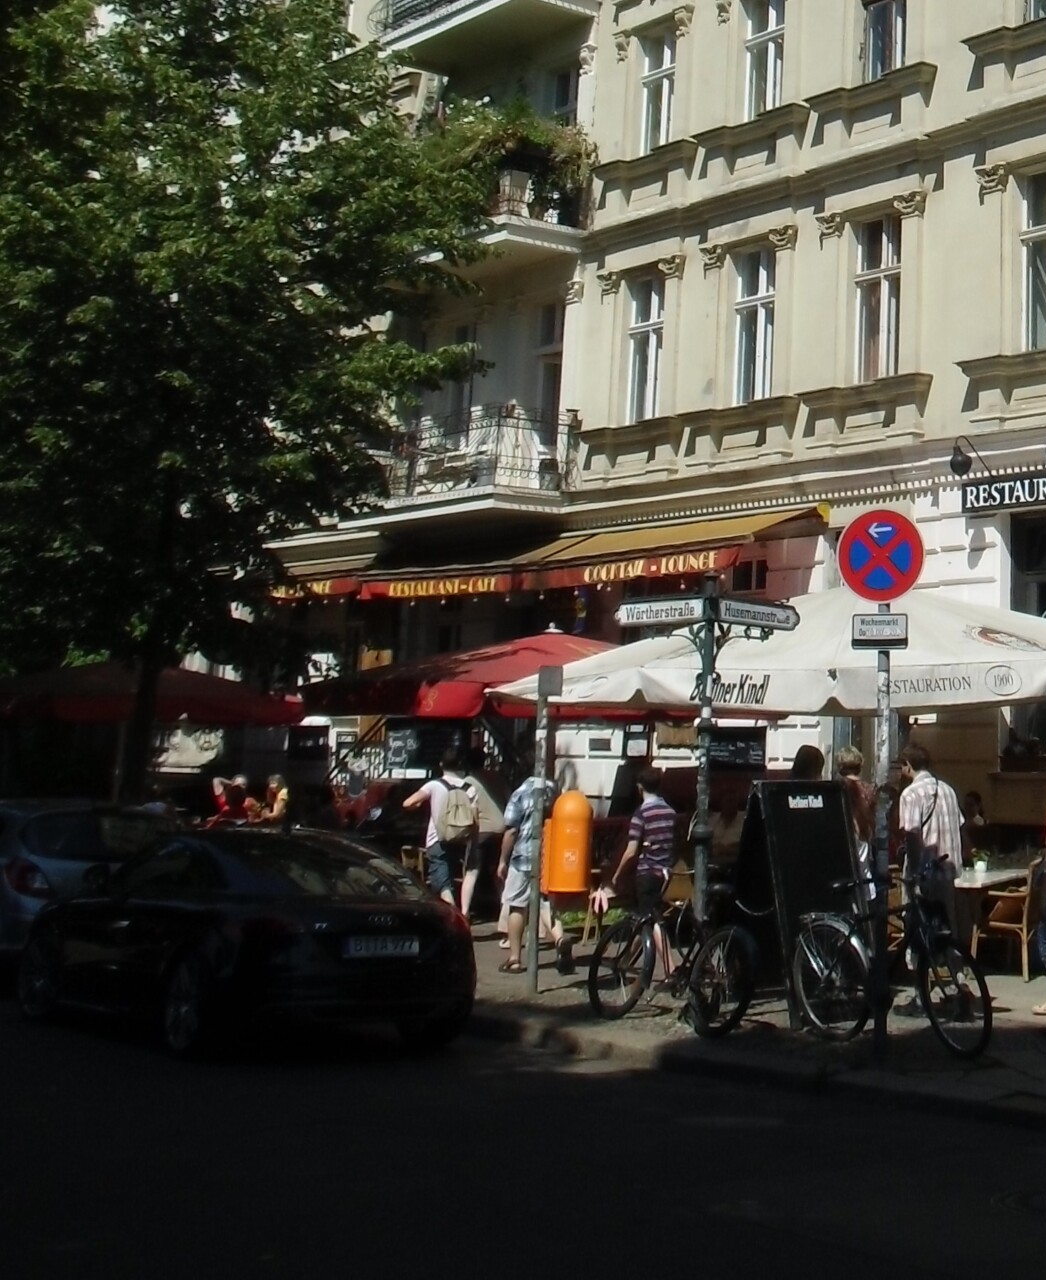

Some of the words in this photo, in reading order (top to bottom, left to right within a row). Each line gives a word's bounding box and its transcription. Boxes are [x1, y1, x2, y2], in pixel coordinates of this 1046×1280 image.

[660, 551, 718, 577] LOUNGE
[625, 602, 695, 621] Wörtherstraße
[724, 602, 791, 625] Husemannstre
[734, 673, 771, 705] Kindl
[888, 676, 972, 695] ESTAURATION
[993, 673, 1014, 688] 1900
